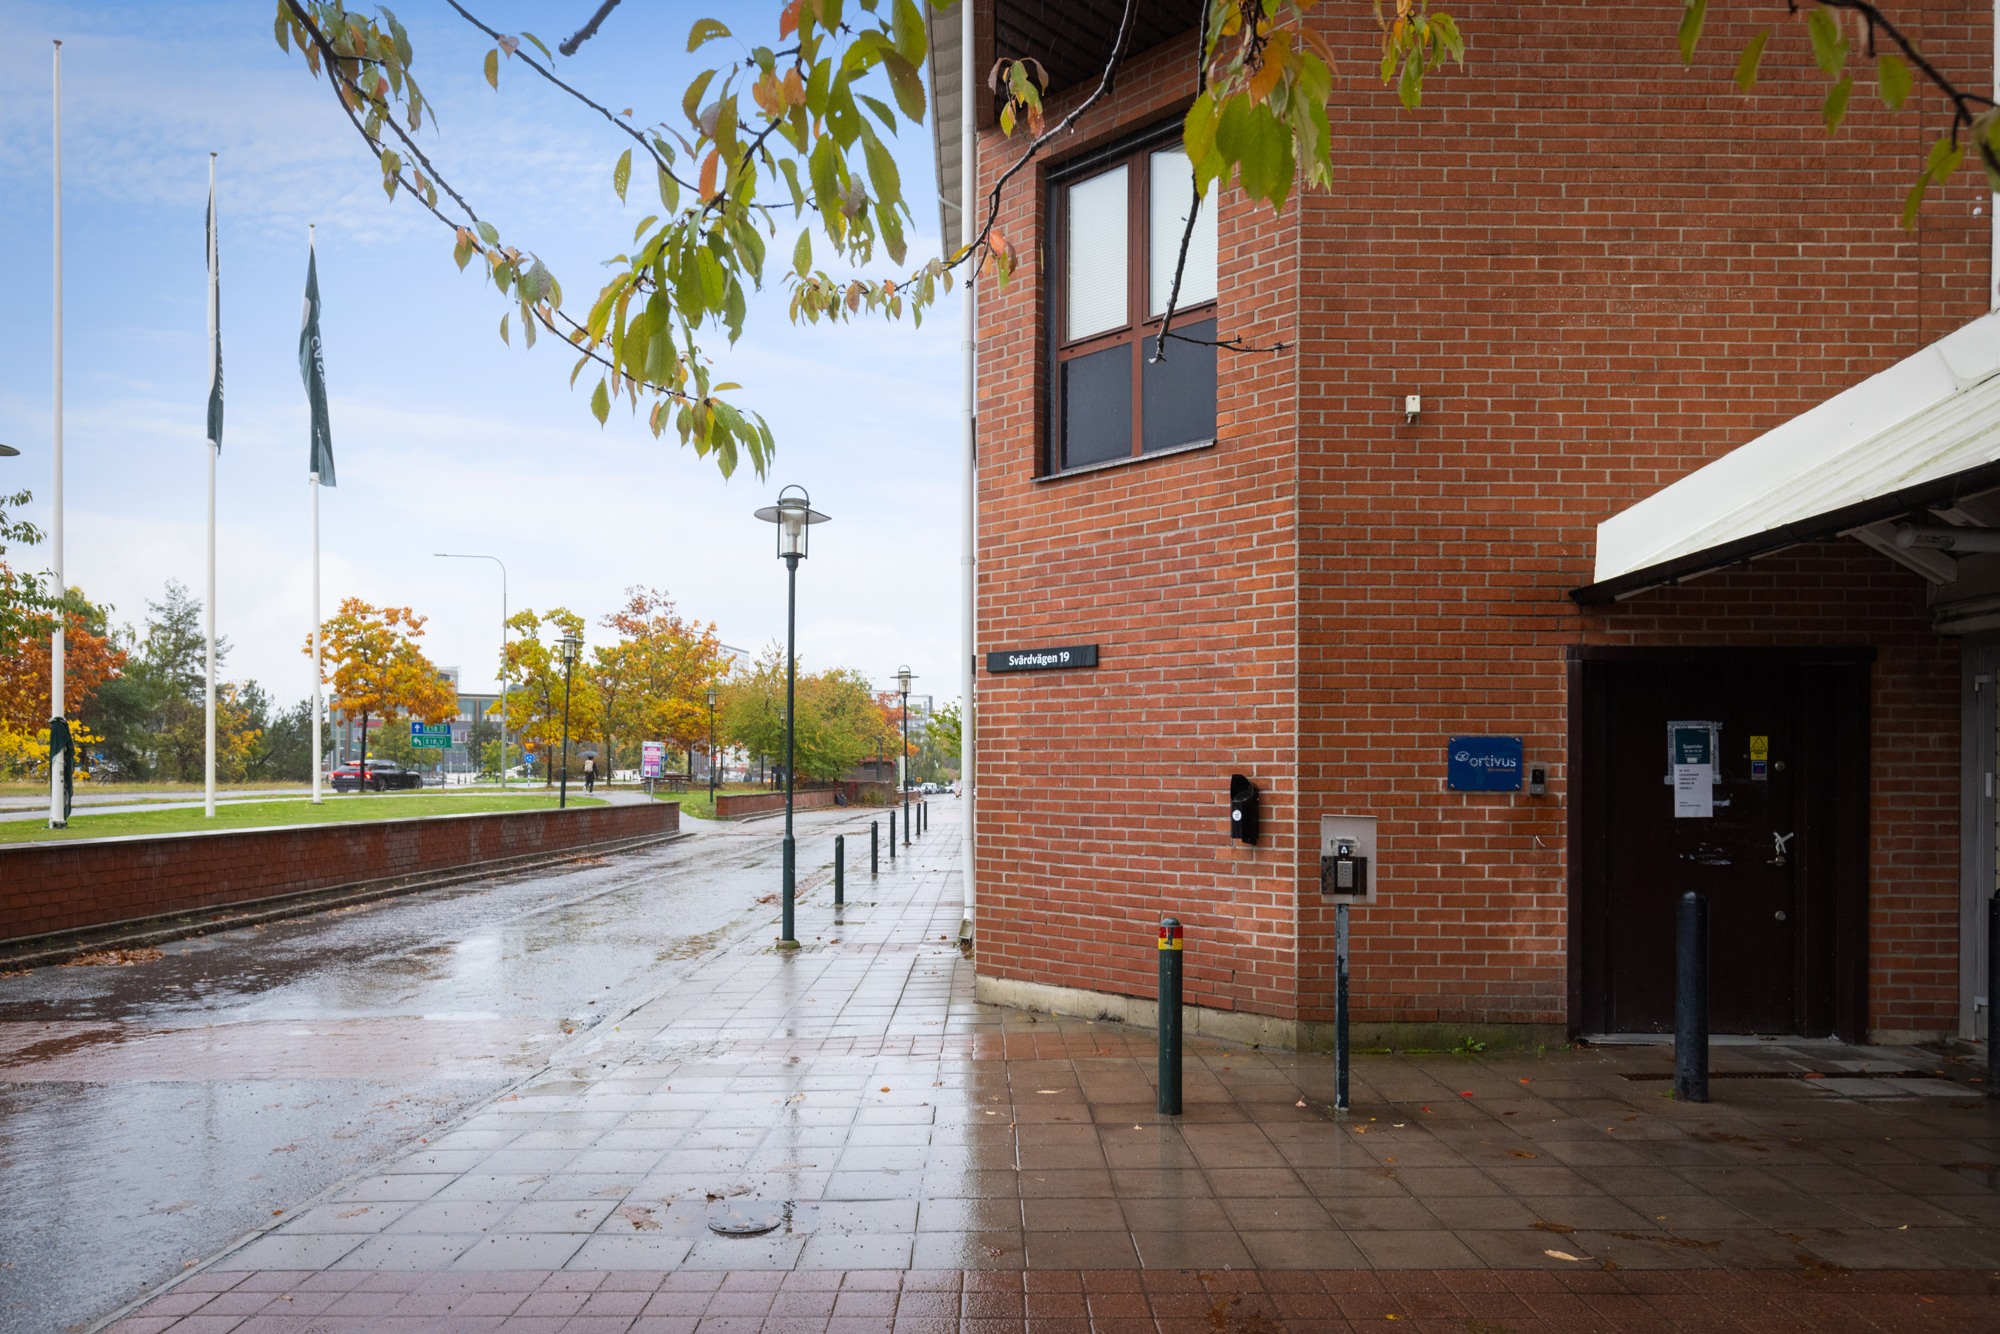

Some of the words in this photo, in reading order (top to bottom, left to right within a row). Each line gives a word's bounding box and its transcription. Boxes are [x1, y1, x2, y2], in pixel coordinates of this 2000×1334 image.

[1009, 653, 1057, 666] Svärdvägen
[1059, 651, 1070, 663] 19
[1469, 755, 1517, 767] ortivus
